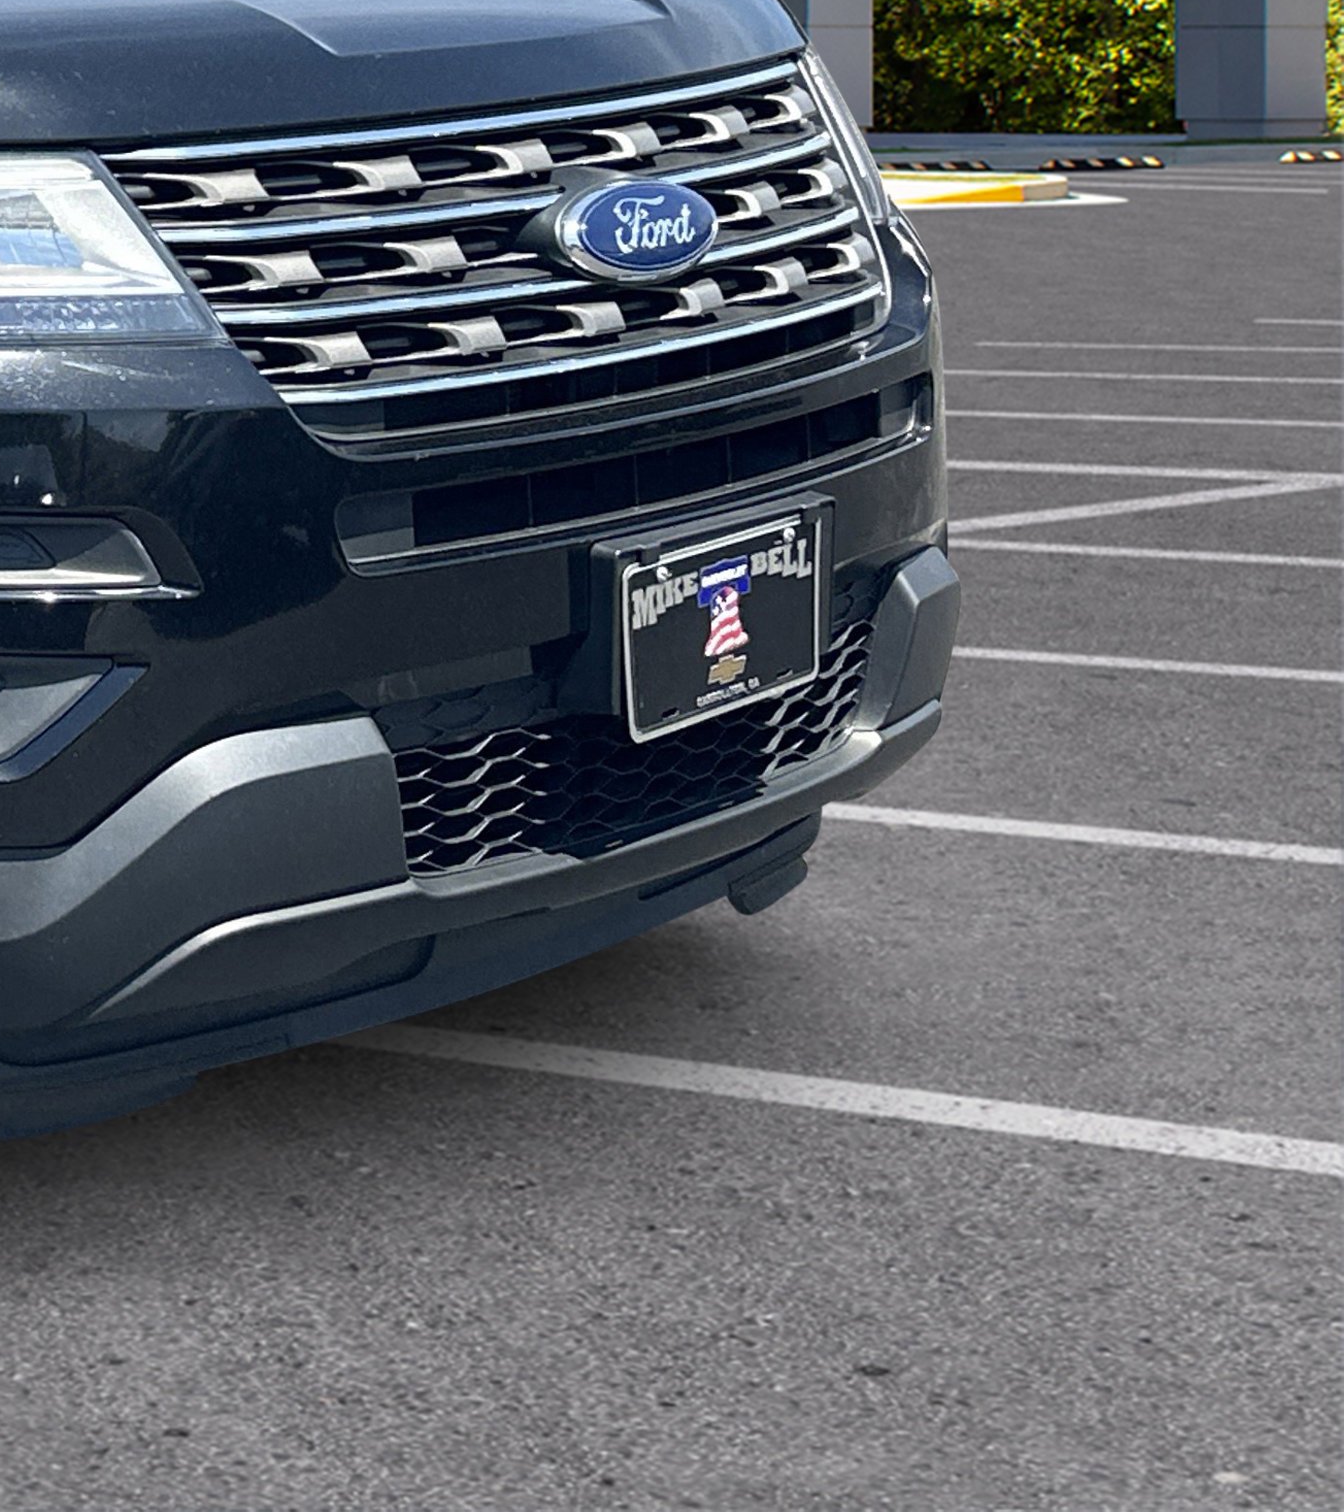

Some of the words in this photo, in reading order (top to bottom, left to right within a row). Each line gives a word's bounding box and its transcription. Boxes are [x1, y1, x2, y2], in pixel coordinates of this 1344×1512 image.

[613, 194, 696, 256] Ford
[631, 571, 699, 630] MIKE
[750, 539, 812, 579] BELL
